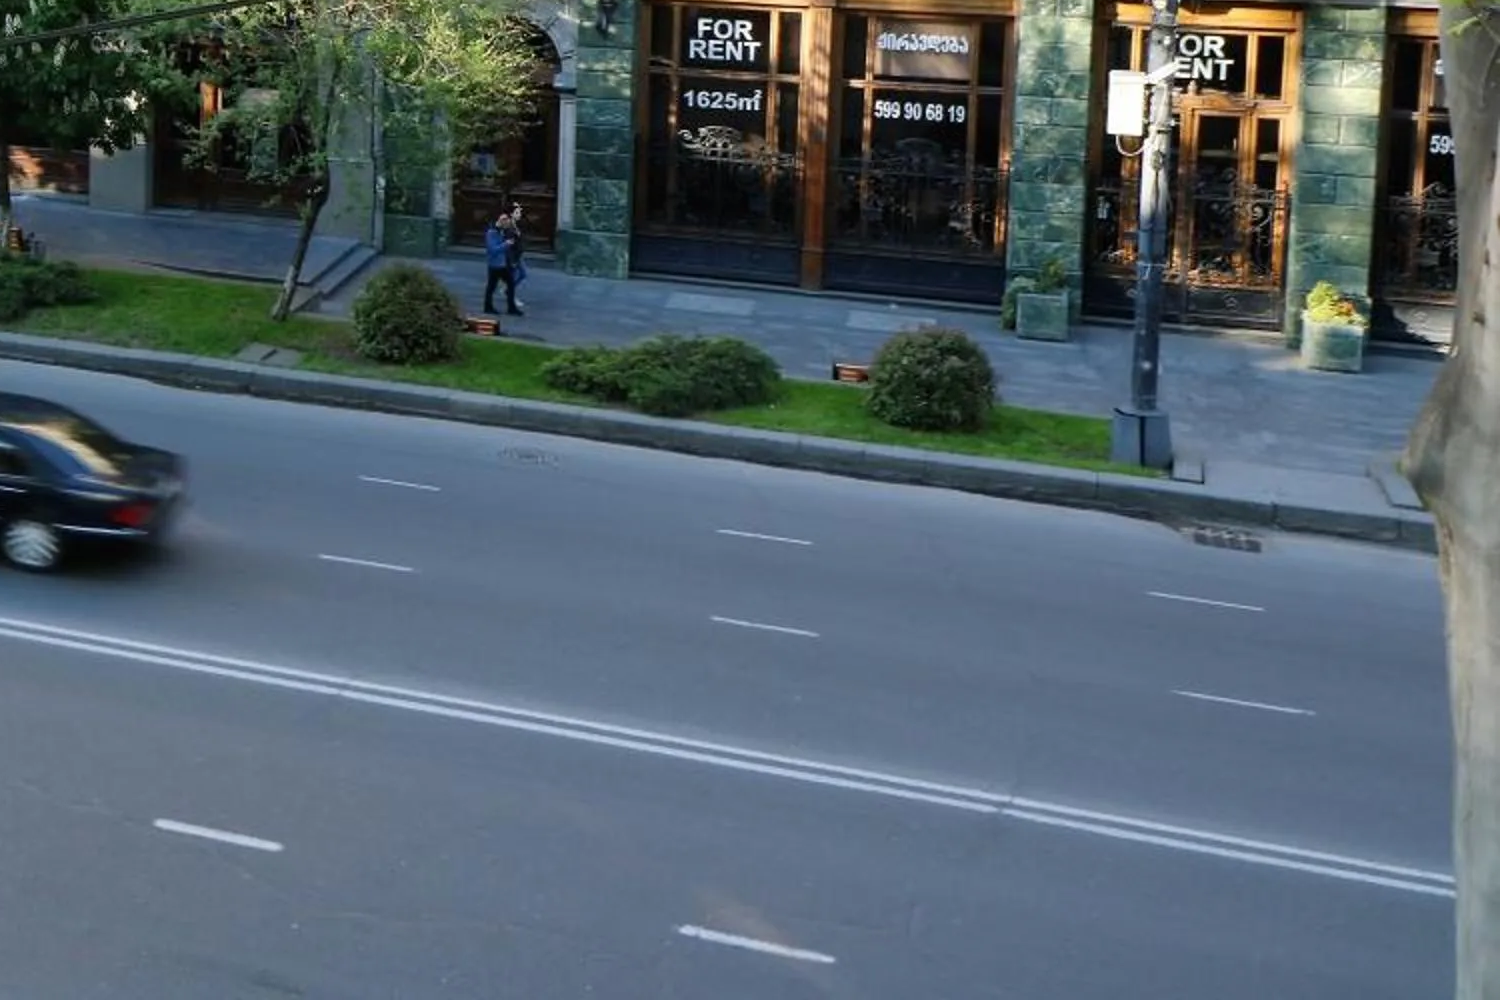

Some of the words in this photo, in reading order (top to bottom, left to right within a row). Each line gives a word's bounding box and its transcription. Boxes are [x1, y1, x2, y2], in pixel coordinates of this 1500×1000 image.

[697, 17, 753, 41] FOR
[689, 39, 761, 62] RENT
[876, 32, 969, 54] ქირავდება
[1176, 33, 1225, 58] OR
[1174, 56, 1235, 80] ENT
[874, 100, 901, 119] 599
[903, 102, 922, 121] 90
[925, 103, 944, 122] 68
[947, 104, 965, 123] 19
